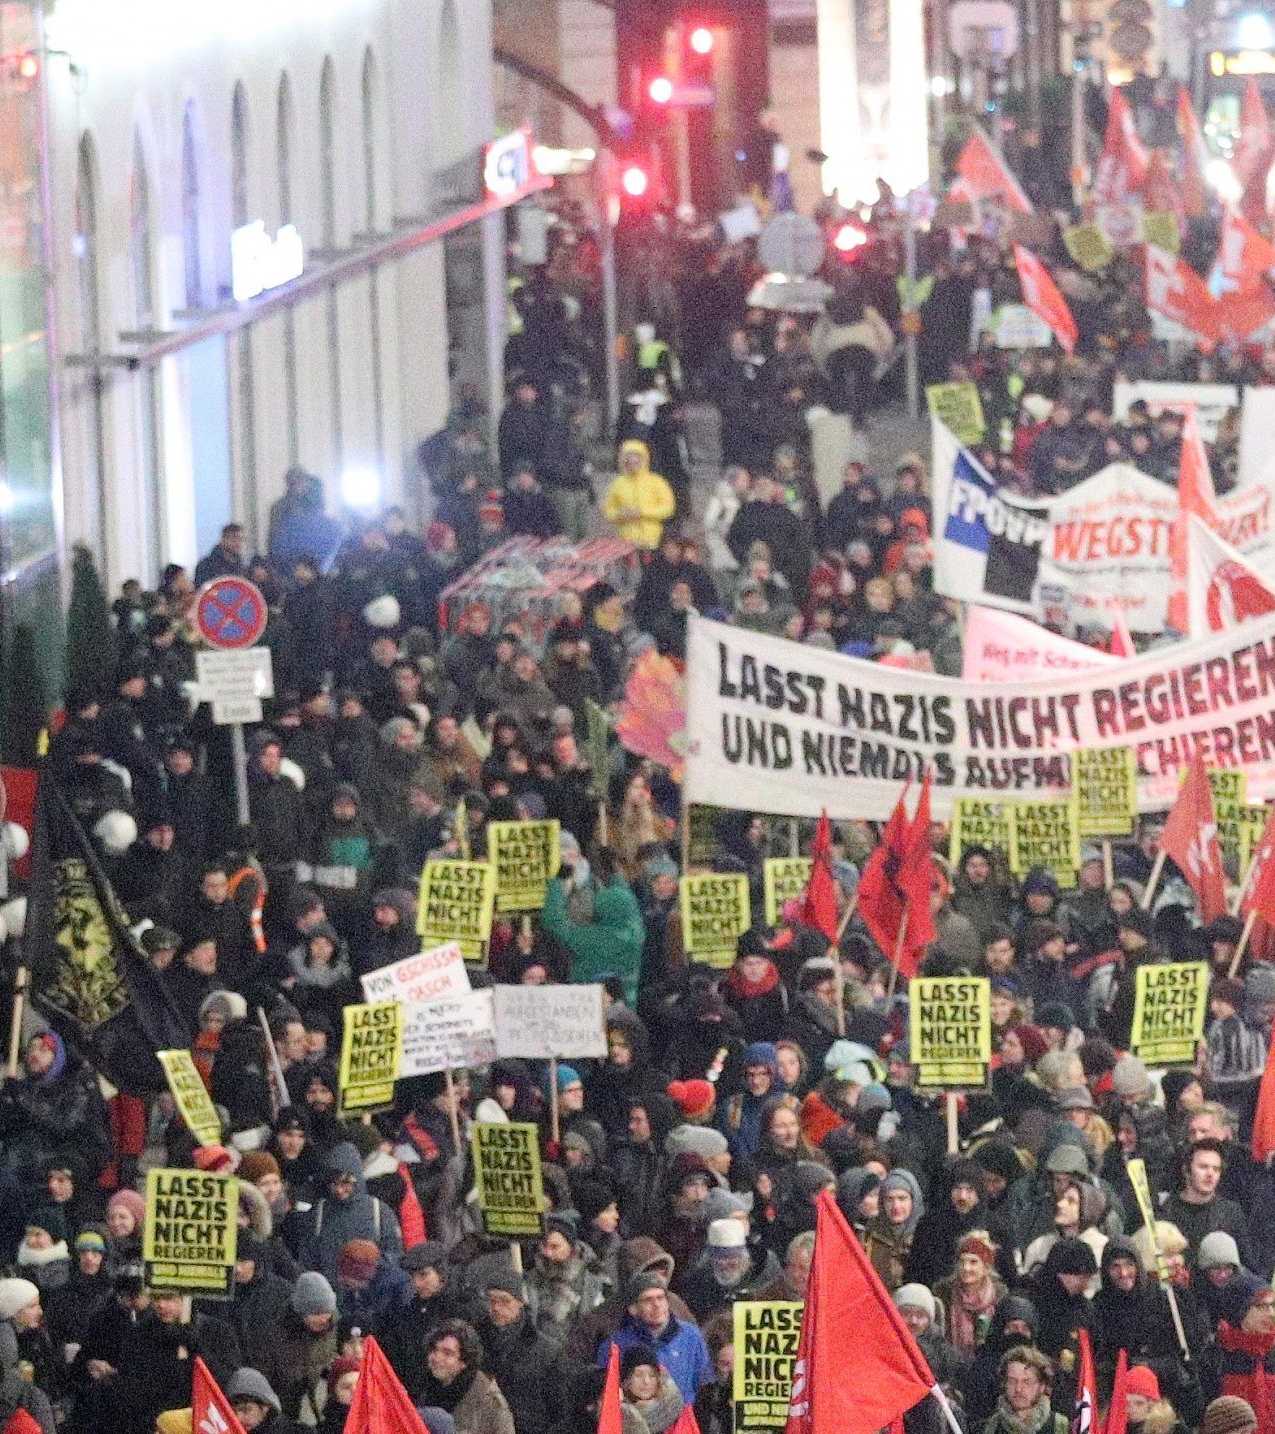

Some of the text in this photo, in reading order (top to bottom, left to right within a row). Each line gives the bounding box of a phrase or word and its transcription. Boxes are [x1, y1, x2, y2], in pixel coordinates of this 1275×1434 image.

[718, 639, 827, 720] LASST
[838, 683, 957, 744] NAZIS
[964, 694, 1082, 750] NICHT
[722, 711, 794, 770] UND
[801, 729, 957, 786] NIEMALS
[1016, 804, 1068, 821] LASST
[1016, 823, 1070, 838] NAZIS
[431, 866, 485, 882] LASST
[429, 884, 483, 903] NAZIS
[428, 904, 481, 923] NICHT
[1147, 967, 1200, 988] LASST
[919, 984, 980, 1002] LASST
[1145, 987, 1199, 1006] NAZIS
[353, 1006, 398, 1030] LASST
[920, 1005, 981, 1023] NAZIS
[1143, 1006, 1197, 1029] NICHT
[351, 1026, 398, 1048] NAZIS
[920, 1026, 981, 1045] NICHT
[349, 1047, 396, 1070] NICHT
[478, 1125, 530, 1149] LASST
[480, 1148, 534, 1171] NAZIS
[156, 1174, 229, 1198] LASST
[482, 1171, 535, 1193] NICHT
[155, 1199, 229, 1222] NAZIS
[154, 1222, 227, 1245] NICHT
[153, 1244, 226, 1261] REGIEREN
[745, 1308, 805, 1331] LASS
[745, 1332, 799, 1355] NAZ
[745, 1382, 790, 1398] REGIE
